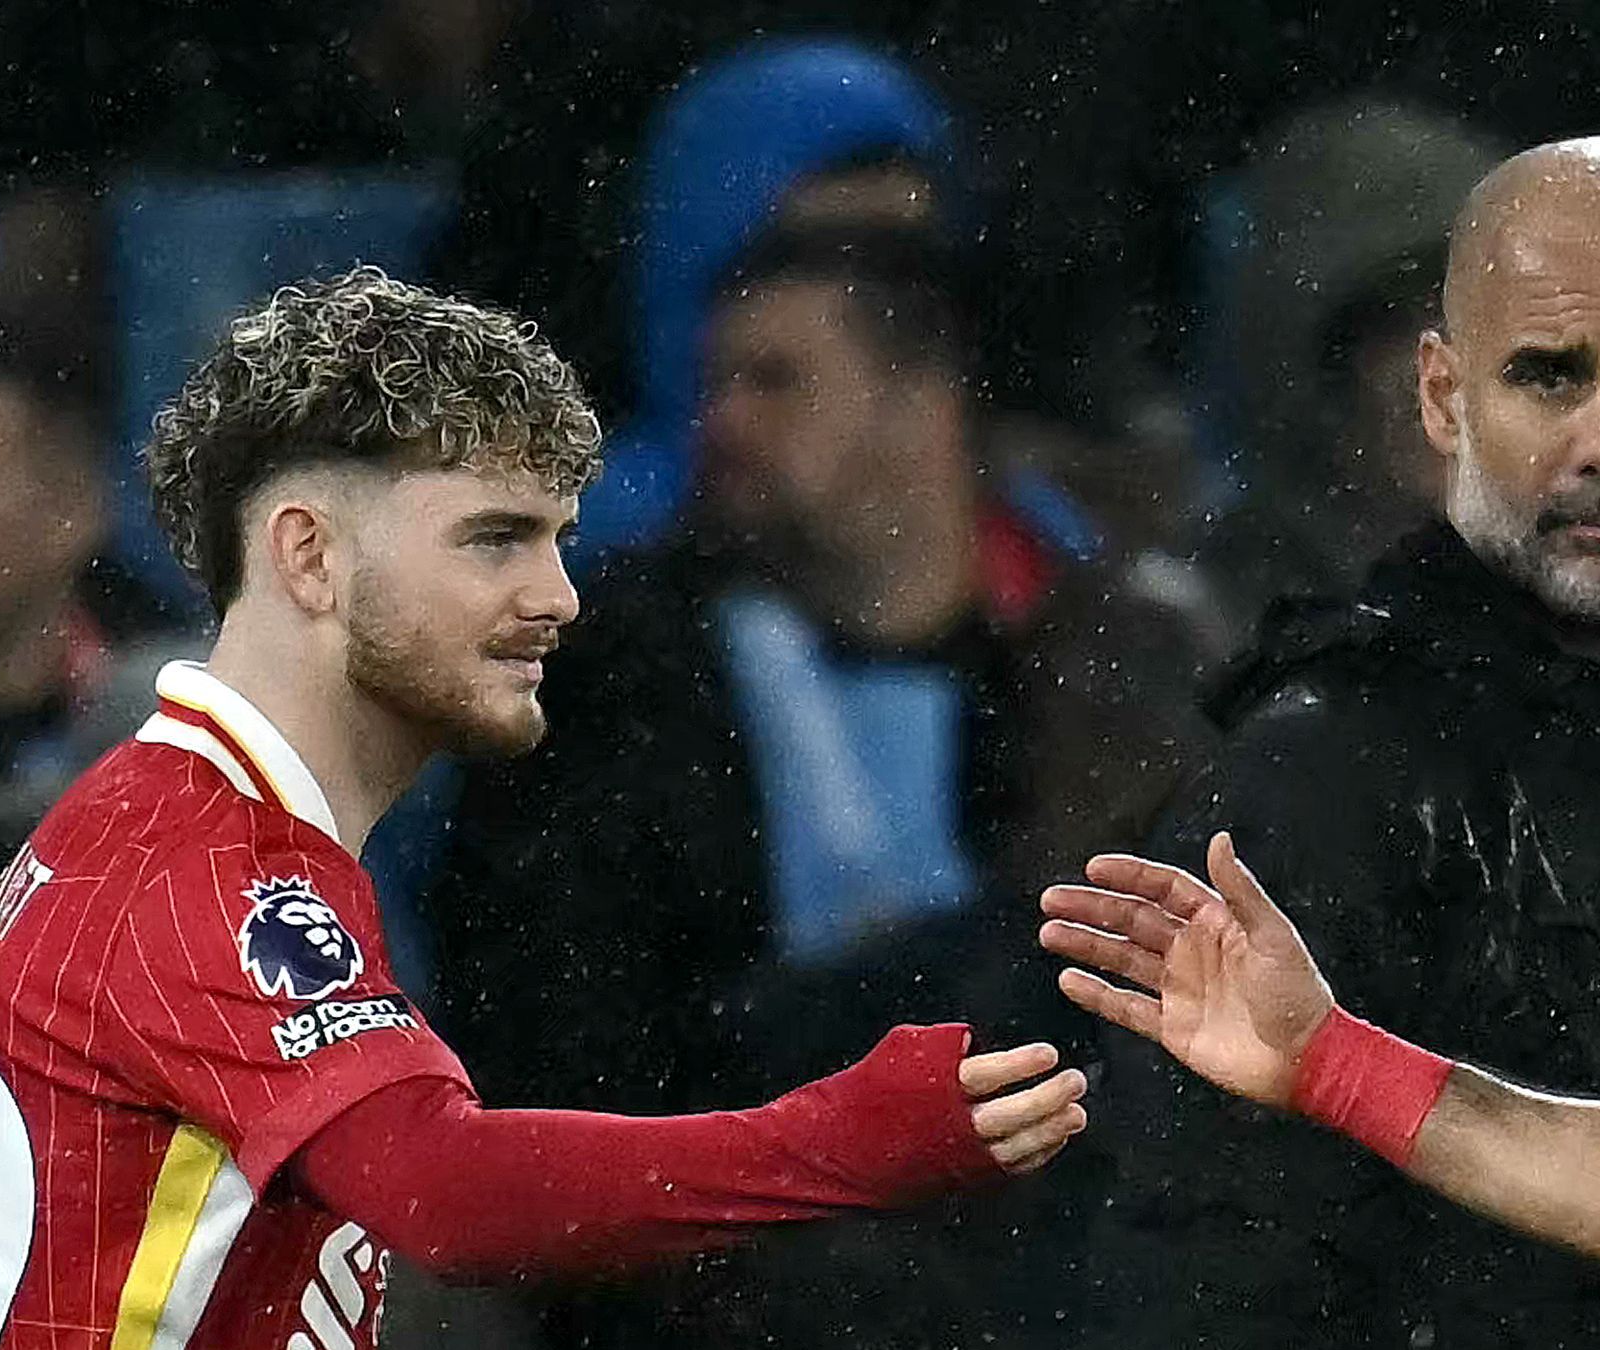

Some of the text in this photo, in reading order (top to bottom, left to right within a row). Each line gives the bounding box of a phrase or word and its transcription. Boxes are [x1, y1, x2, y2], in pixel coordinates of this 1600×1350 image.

[271, 1000, 397, 1042] No room
[323, 1013, 420, 1044] racism
